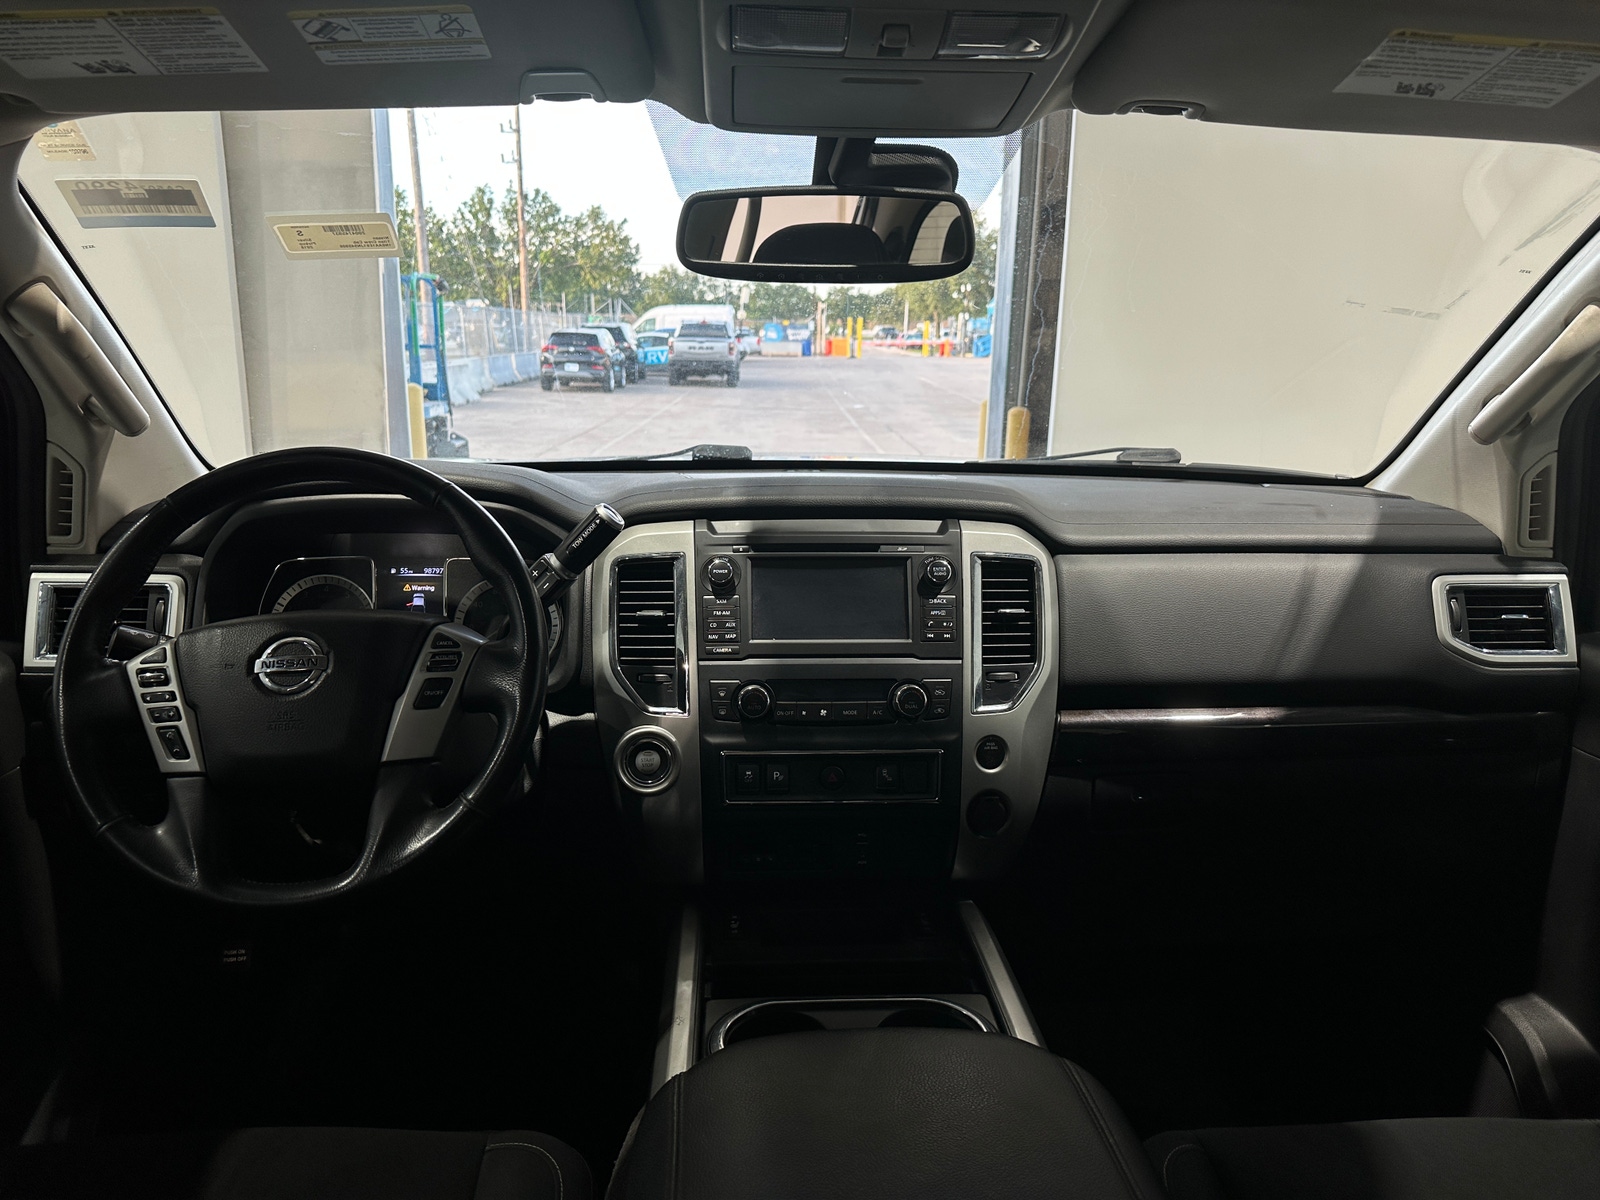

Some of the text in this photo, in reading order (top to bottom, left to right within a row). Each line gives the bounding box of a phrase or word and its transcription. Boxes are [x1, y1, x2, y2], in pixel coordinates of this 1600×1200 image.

[572, 523, 597, 548] TOW MODE
[262, 658, 318, 669] NISSAN
